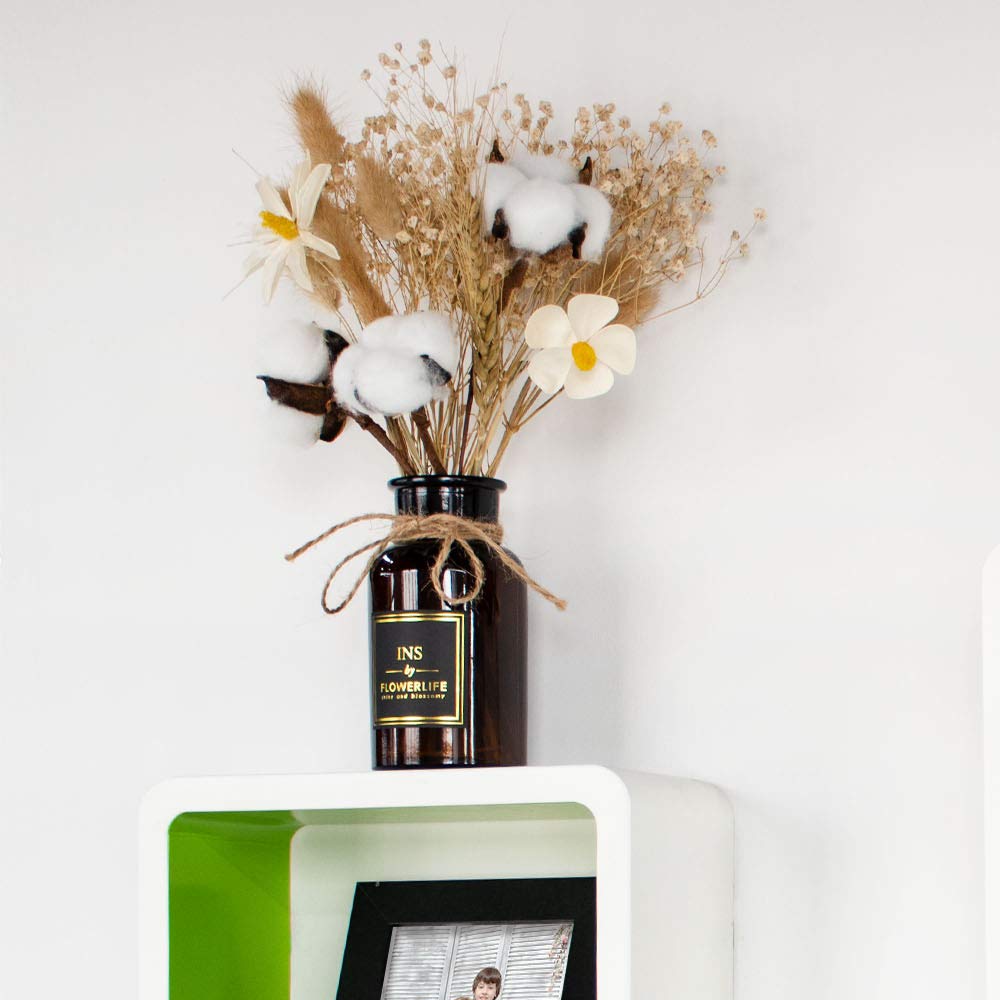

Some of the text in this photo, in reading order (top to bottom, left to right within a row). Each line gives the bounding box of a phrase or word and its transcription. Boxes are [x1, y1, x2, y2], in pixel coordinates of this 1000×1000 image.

[397, 646, 423, 661] INS
[403, 664, 416, 678] by
[380, 681, 448, 692] FLOWERLIFE
